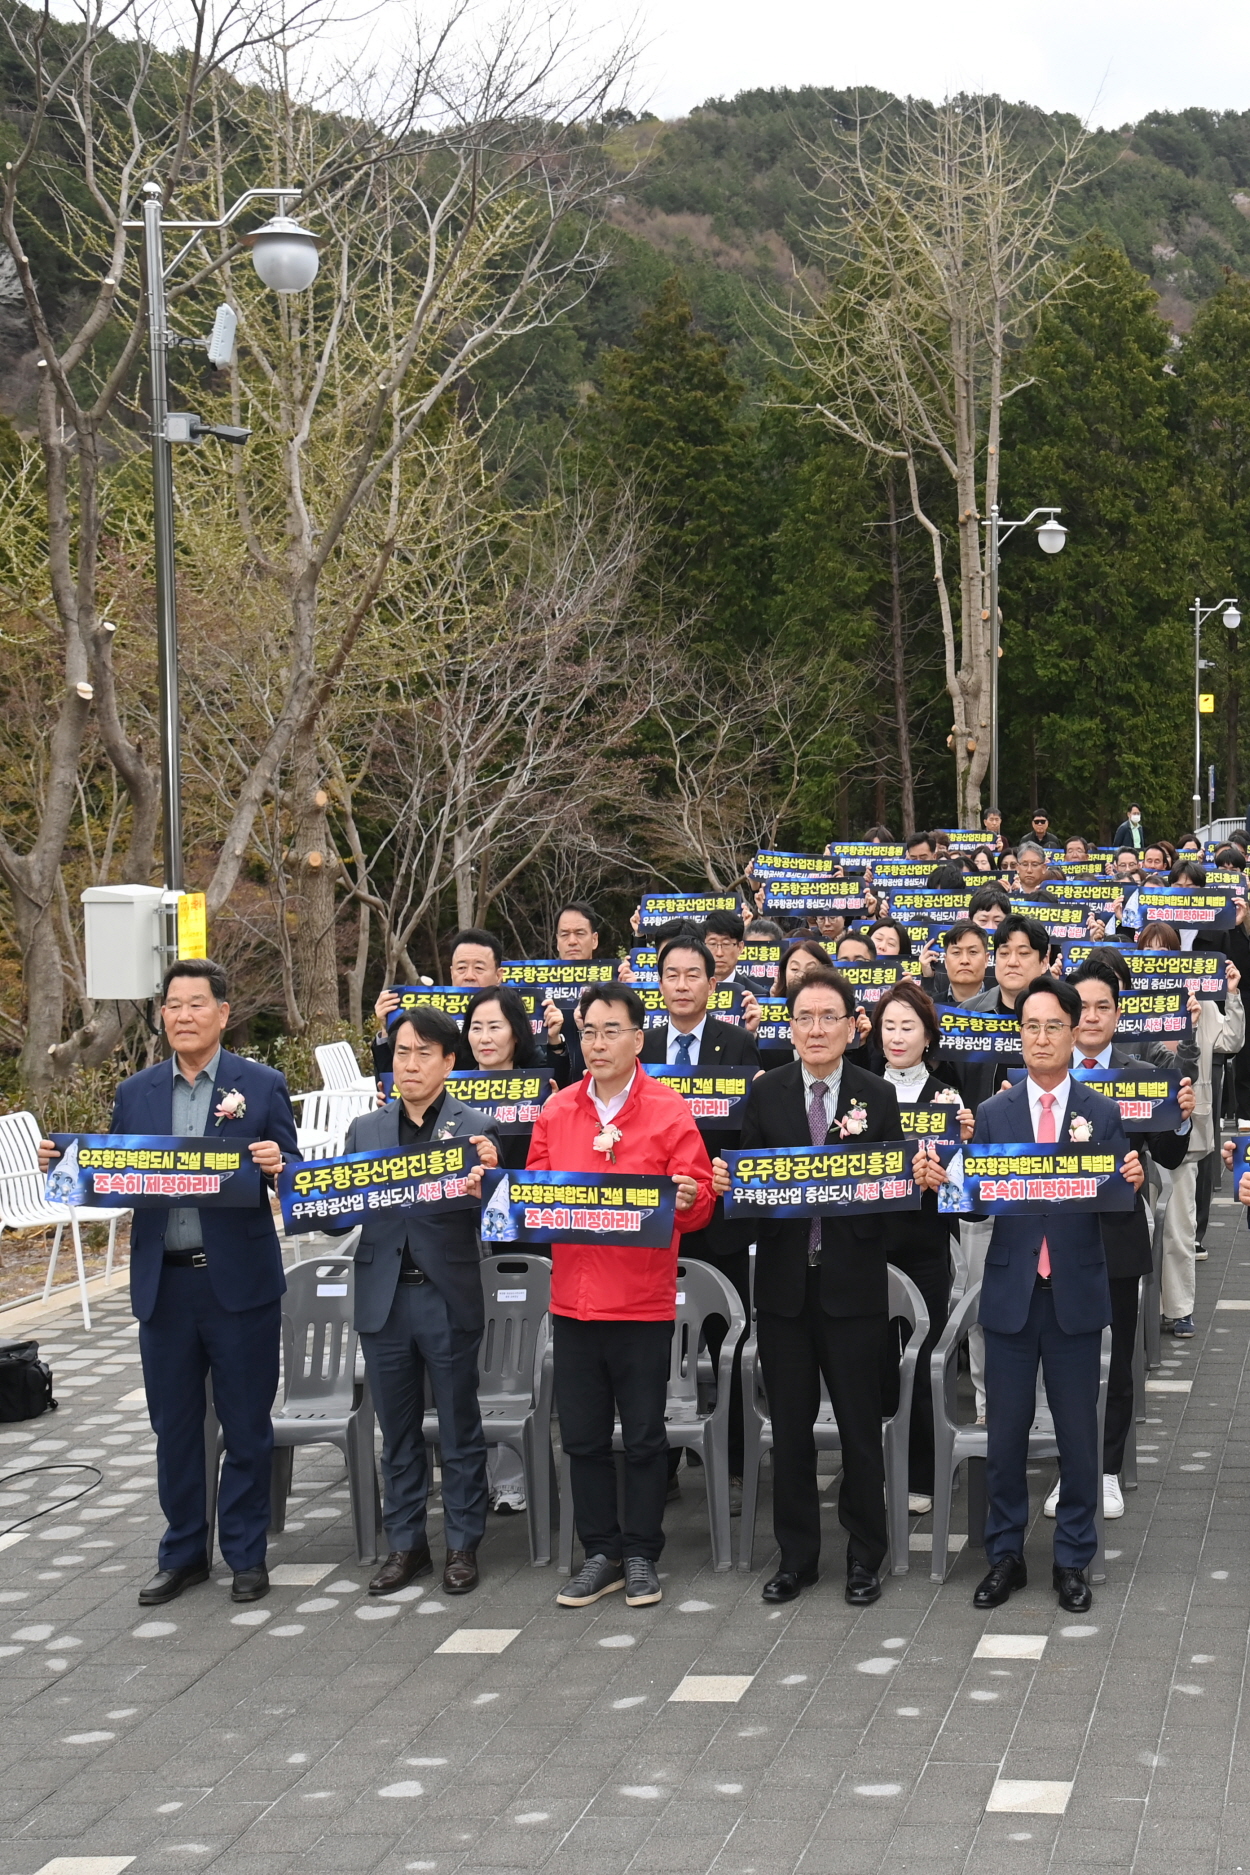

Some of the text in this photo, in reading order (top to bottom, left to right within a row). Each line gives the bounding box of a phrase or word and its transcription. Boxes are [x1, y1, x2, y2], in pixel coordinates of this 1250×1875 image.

[757, 855, 832, 871] 우주항공산업진흥원
[770, 882, 859, 896] 우주항공산업진흥원
[893, 895, 972, 908] 우주항공산업진흥
[1139, 895, 1190, 906] 우주항공복합도시
[1147, 908, 1215, 921] 조속히 제정하라!!
[1124, 958, 1217, 974] 항공산업진흥원
[545, 987, 577, 999] 중심도시
[1151, 979, 1223, 992] 중심도시 사천 설립!
[1115, 1017, 1187, 1032] 심도시 사천 설립!
[994, 1037, 1022, 1051] 중심도
[693, 1077, 713, 1094] 건설
[715, 1077, 745, 1095] 특별법
[1115, 1082, 1136, 1098] 건설
[1137, 1081, 1168, 1098] 특별법
[494, 1105, 541, 1122] 사천 설립
[685, 1099, 729, 1116] 하라!!
[1119, 1101, 1152, 1118] 하라!!
[78, 1149, 240, 1170] 우주항공복합도시 건설 특별법
[736, 1151, 903, 1181] 우주항공산업진흥원
[964, 1154, 1115, 1176] 우주항공복합도시 건설 특별법
[294, 1147, 464, 1195] 우주항공산업진흥원
[93, 1173, 220, 1194] 조속히 제정하라!!
[980, 1178, 1097, 1200] 조속히 제정하라!!
[292, 1177, 468, 1219] 우주항공산업 중심도시 사천 설립
[510, 1184, 659, 1206] 우주항공복합도시 건설 특별법
[733, 1180, 913, 1205] 우주항공산업 중심도시 사천 설립!
[525, 1208, 641, 1231] 조속히 제정하라!!
